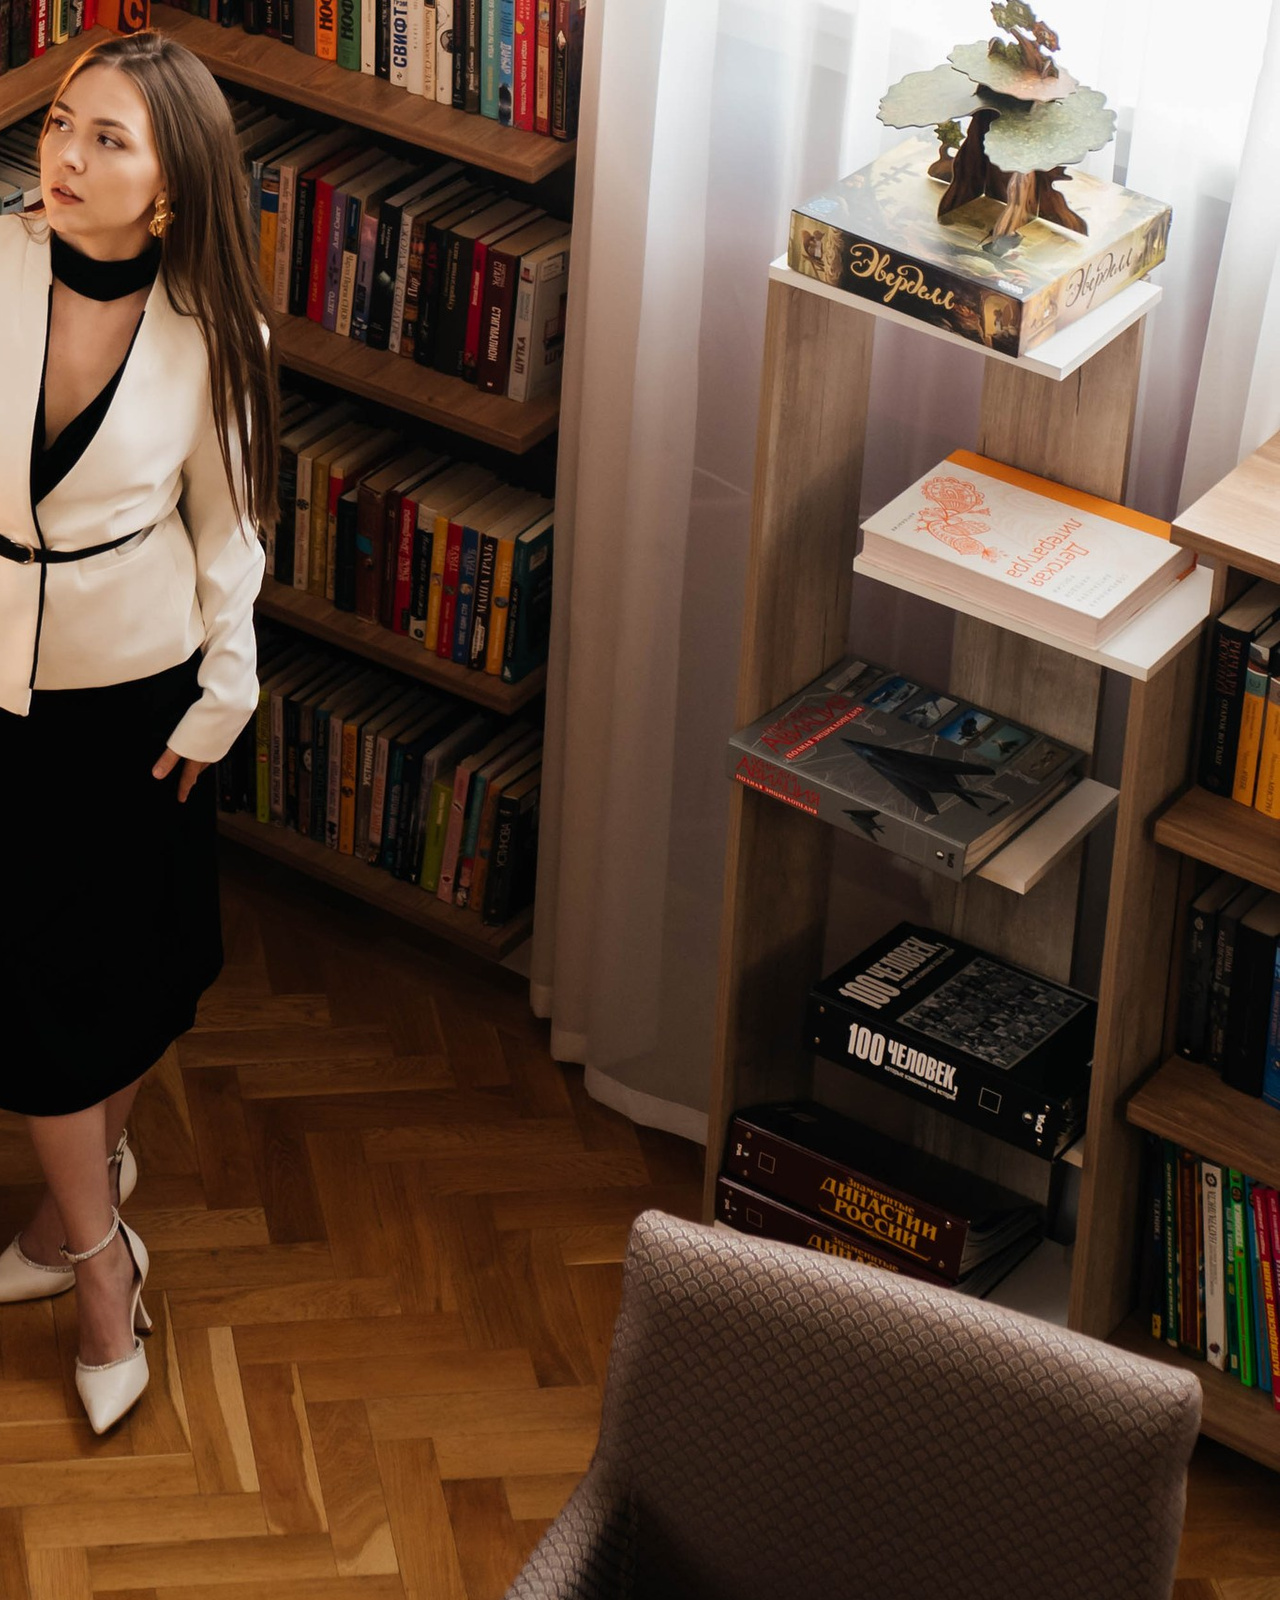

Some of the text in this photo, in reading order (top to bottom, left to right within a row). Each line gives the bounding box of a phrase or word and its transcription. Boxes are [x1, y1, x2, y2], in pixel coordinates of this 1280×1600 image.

[37, 19, 46, 48] БОРИС
[393, 8, 407, 68] СВИФТ
[327, 291, 335, 315] ЛЕТО
[850, 244, 955, 311] Эверделл
[1065, 250, 1134, 308] Эверделл
[487, 307, 501, 362] СТИГМАЛИОН
[515, 336, 526, 375] ШУТКА
[1005, 517, 1082, 579] литература
[1027, 542, 1089, 588] Детская
[1225, 640, 1241, 696] РИЧАРД
[786, 706, 864, 760] ПОЛНАЯ ЭНЦИКЛОПЕДИЯ
[736, 774, 818, 815] ПОЛНАЯ ЭНЦИКЛОПЕДИЯ
[839, 978, 901, 1009] 100
[875, 936, 949, 989] ЧЕЛОВЕК,
[847, 1023, 886, 1067] 100
[887, 1037, 958, 1098] ЧЕЛОВЕК,
[820, 1176, 938, 1242] ДИНАСТИИ
[847, 1176, 915, 1215] Знаменитые
[834, 1197, 918, 1250] РОССИИ
[831, 1234, 900, 1273] Знаменитые
[1262, 1261, 1280, 1377] КАЛЕЙДОСКОП ЗНАНИЙ
